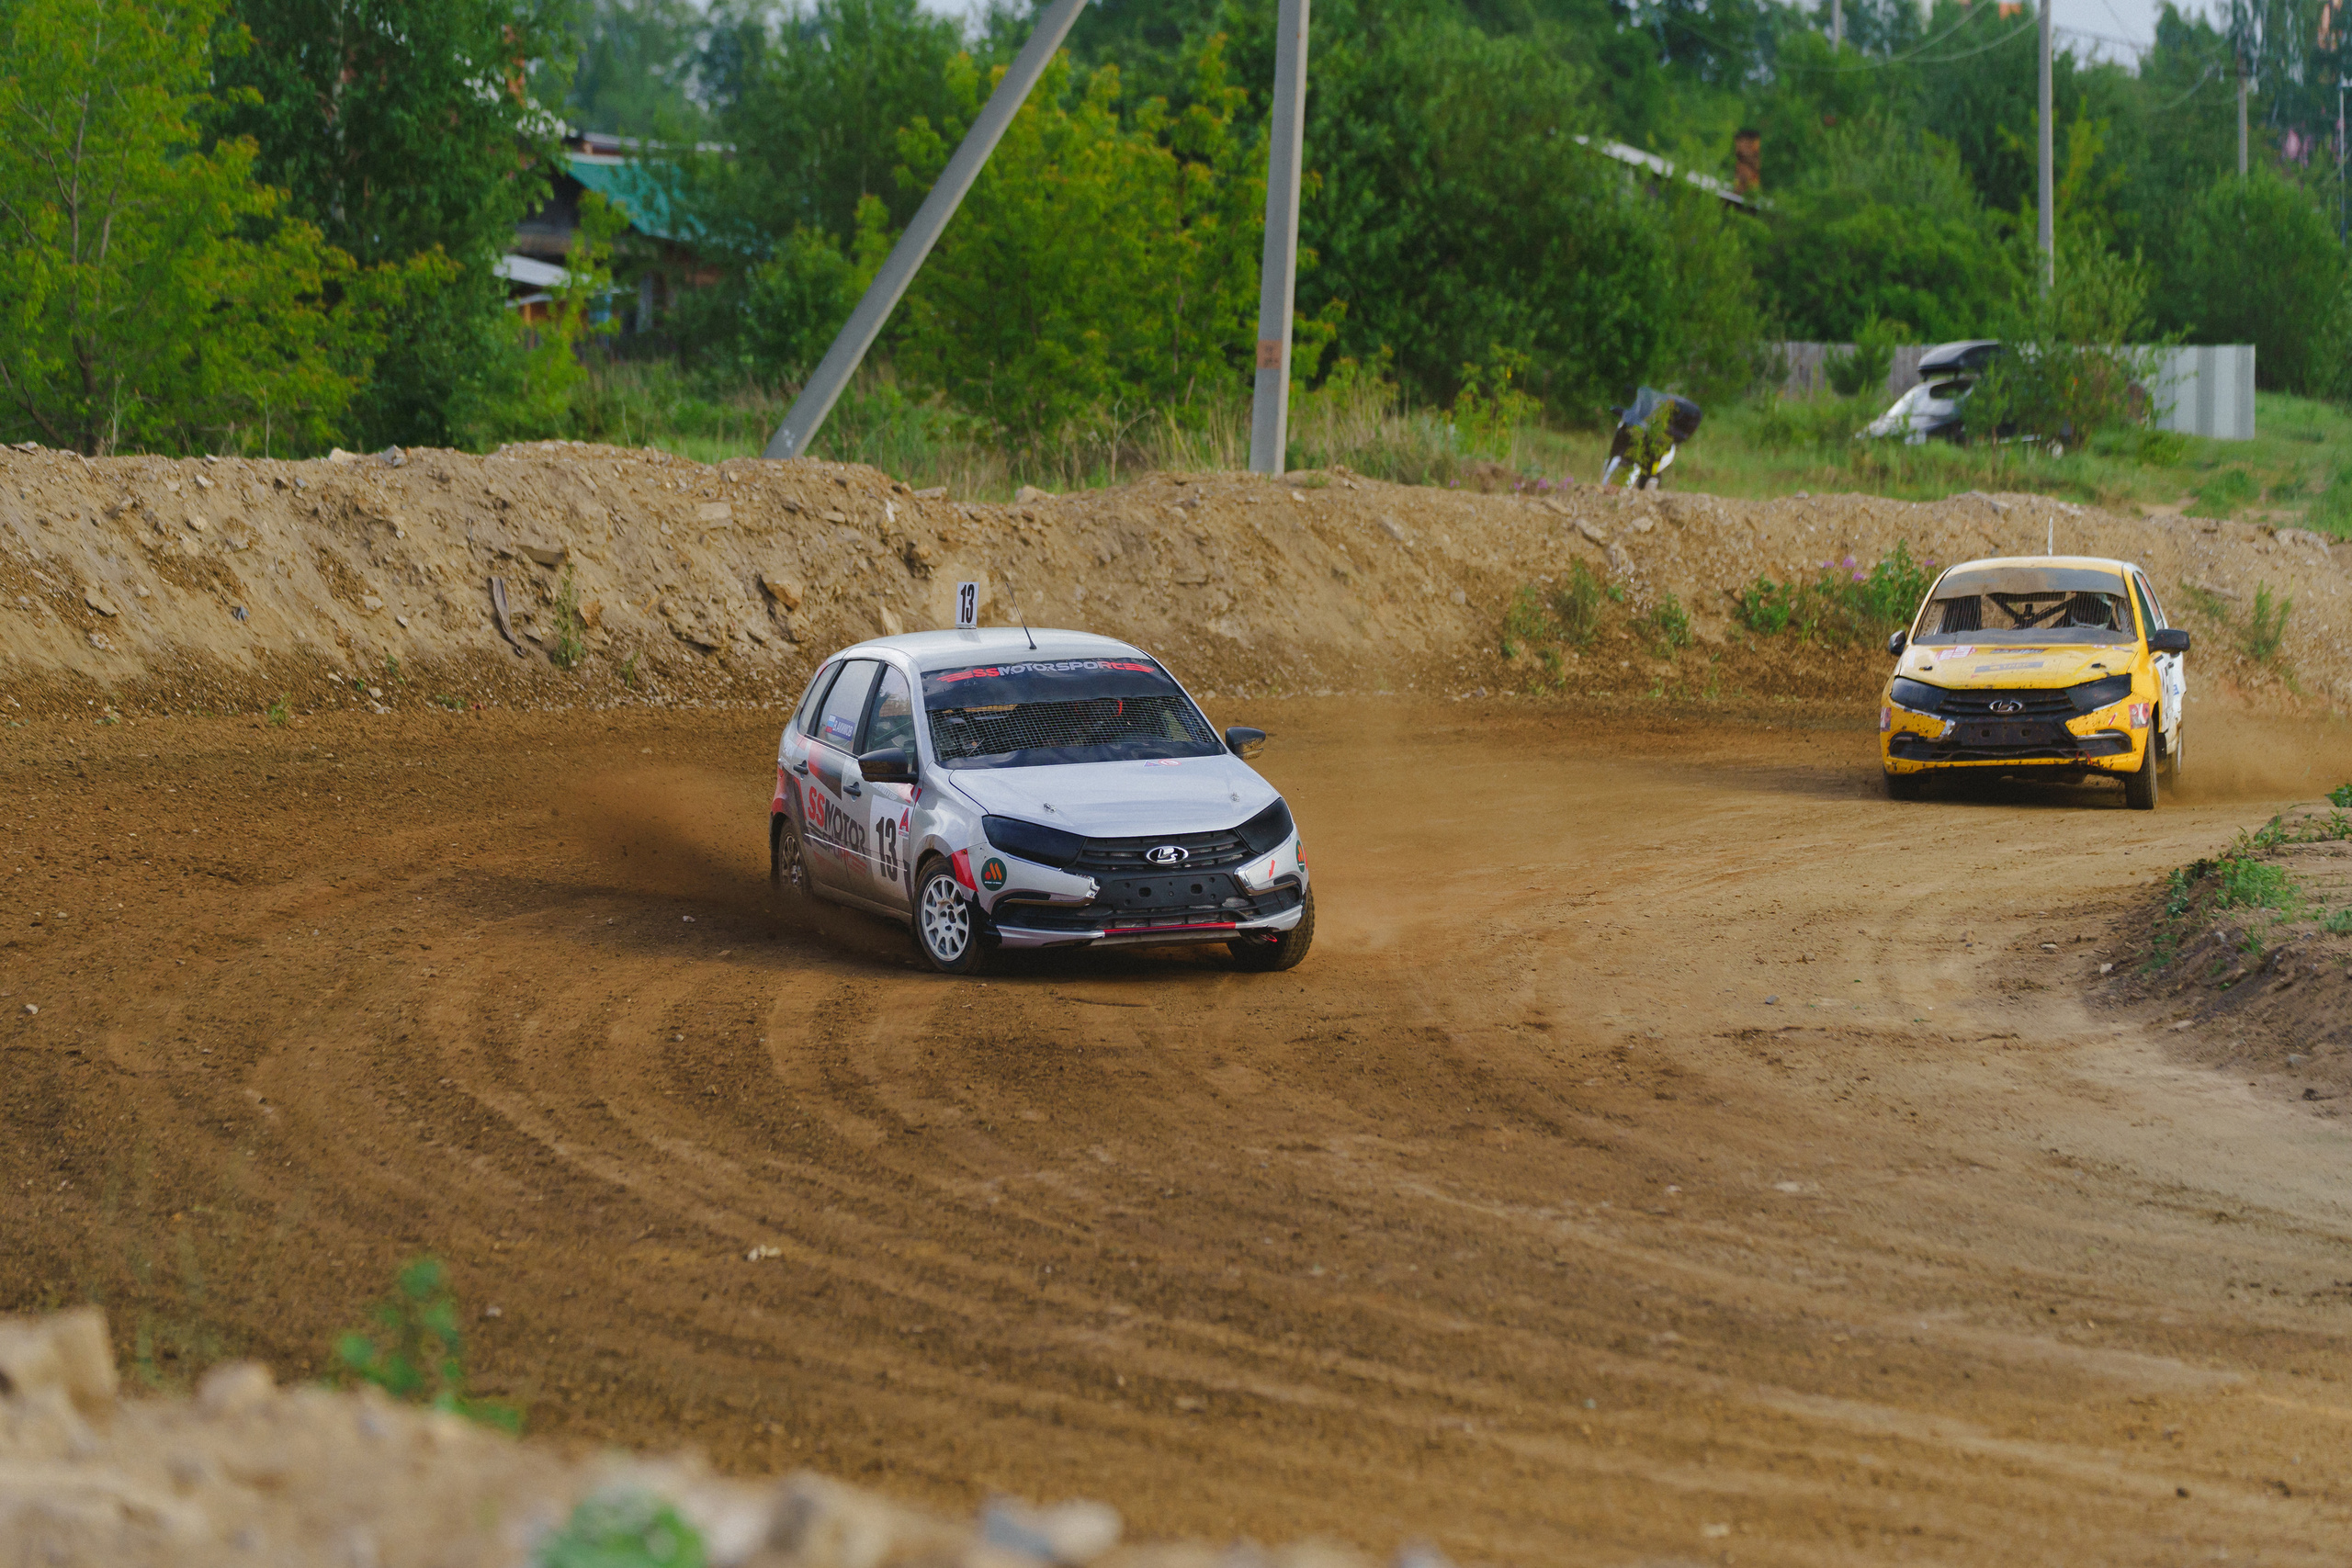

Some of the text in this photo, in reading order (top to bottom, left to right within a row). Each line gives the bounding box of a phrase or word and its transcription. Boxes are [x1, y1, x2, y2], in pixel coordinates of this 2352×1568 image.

[960, 583, 975, 624] 13
[808, 786, 866, 861] SSMOTOR
[876, 816, 898, 882] 13
